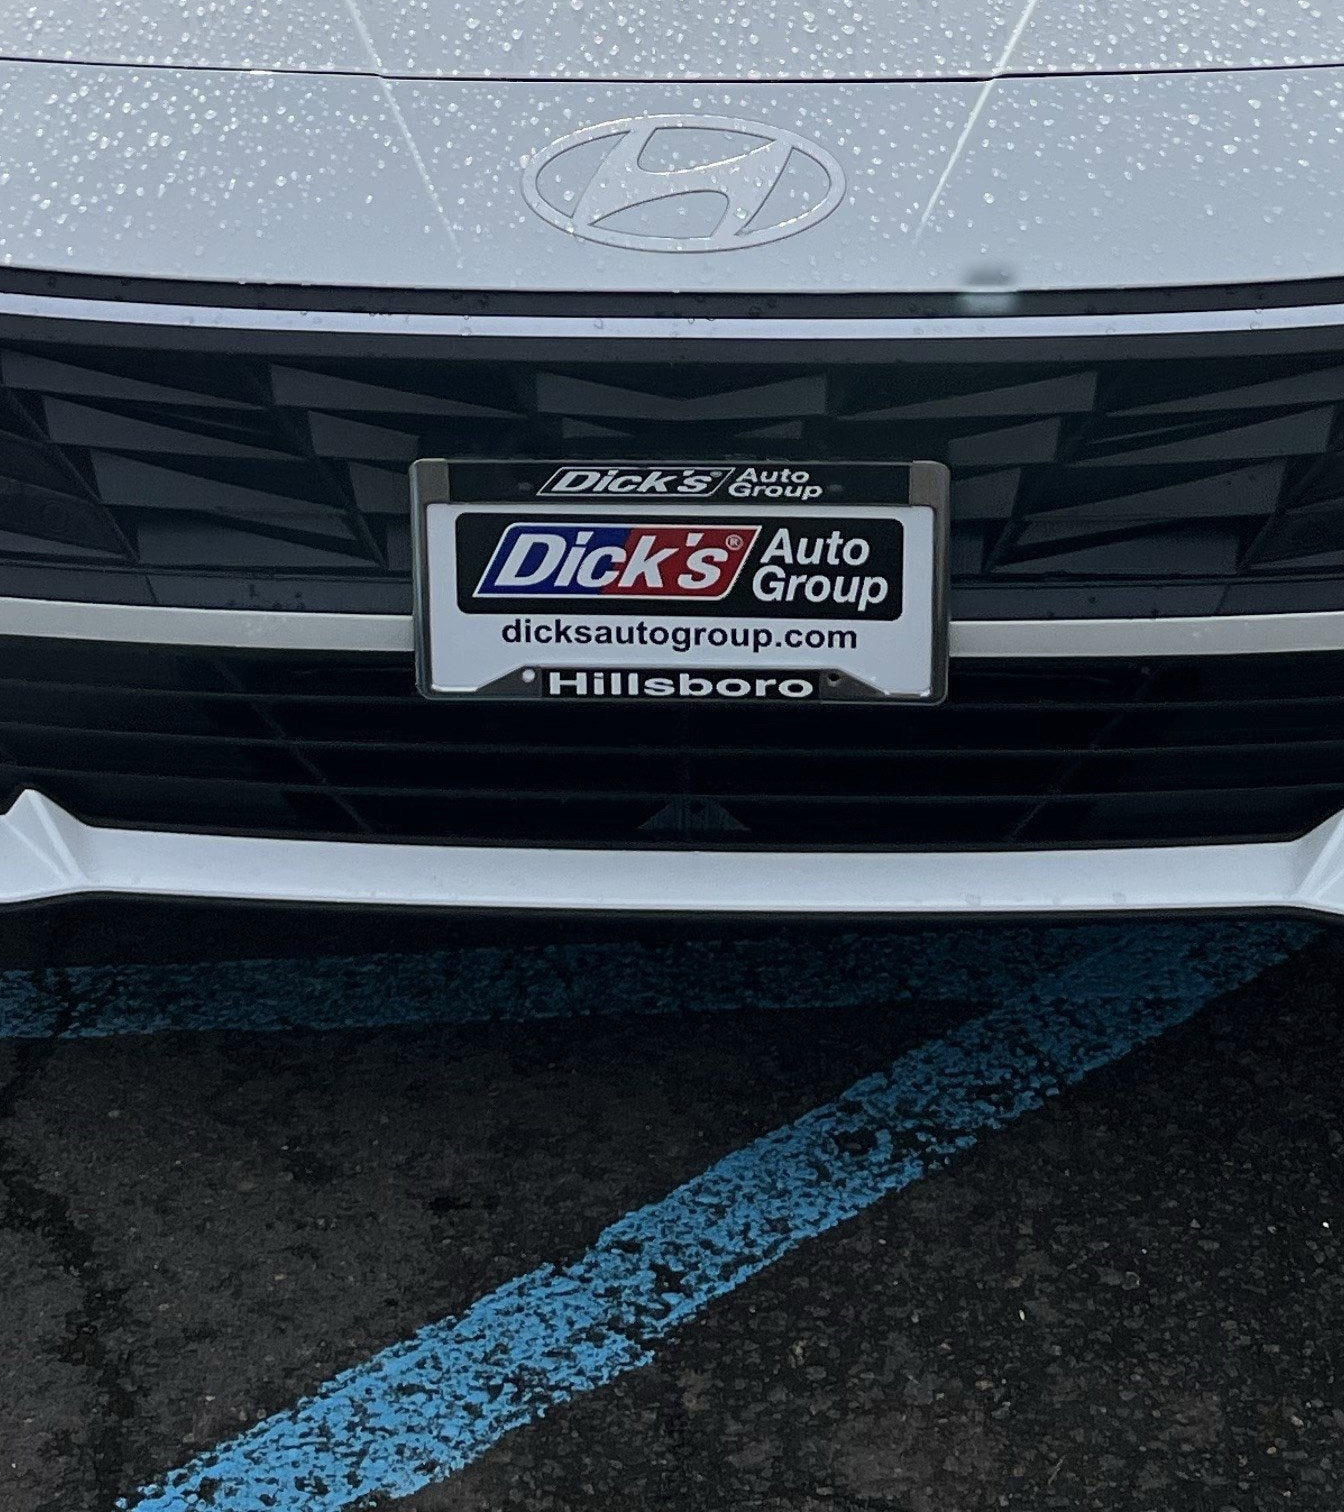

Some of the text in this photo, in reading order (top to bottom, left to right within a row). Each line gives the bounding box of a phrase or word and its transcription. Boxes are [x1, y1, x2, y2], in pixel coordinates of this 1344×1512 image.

[551, 468, 714, 494] Dick's
[735, 467, 810, 484] Auto
[727, 482, 824, 501] Group
[494, 531, 730, 589] Dick's
[759, 527, 871, 566] Auto
[752, 564, 889, 612] Group
[501, 618, 858, 653] dicksautogroup.com
[548, 671, 814, 698] Hillsboro
